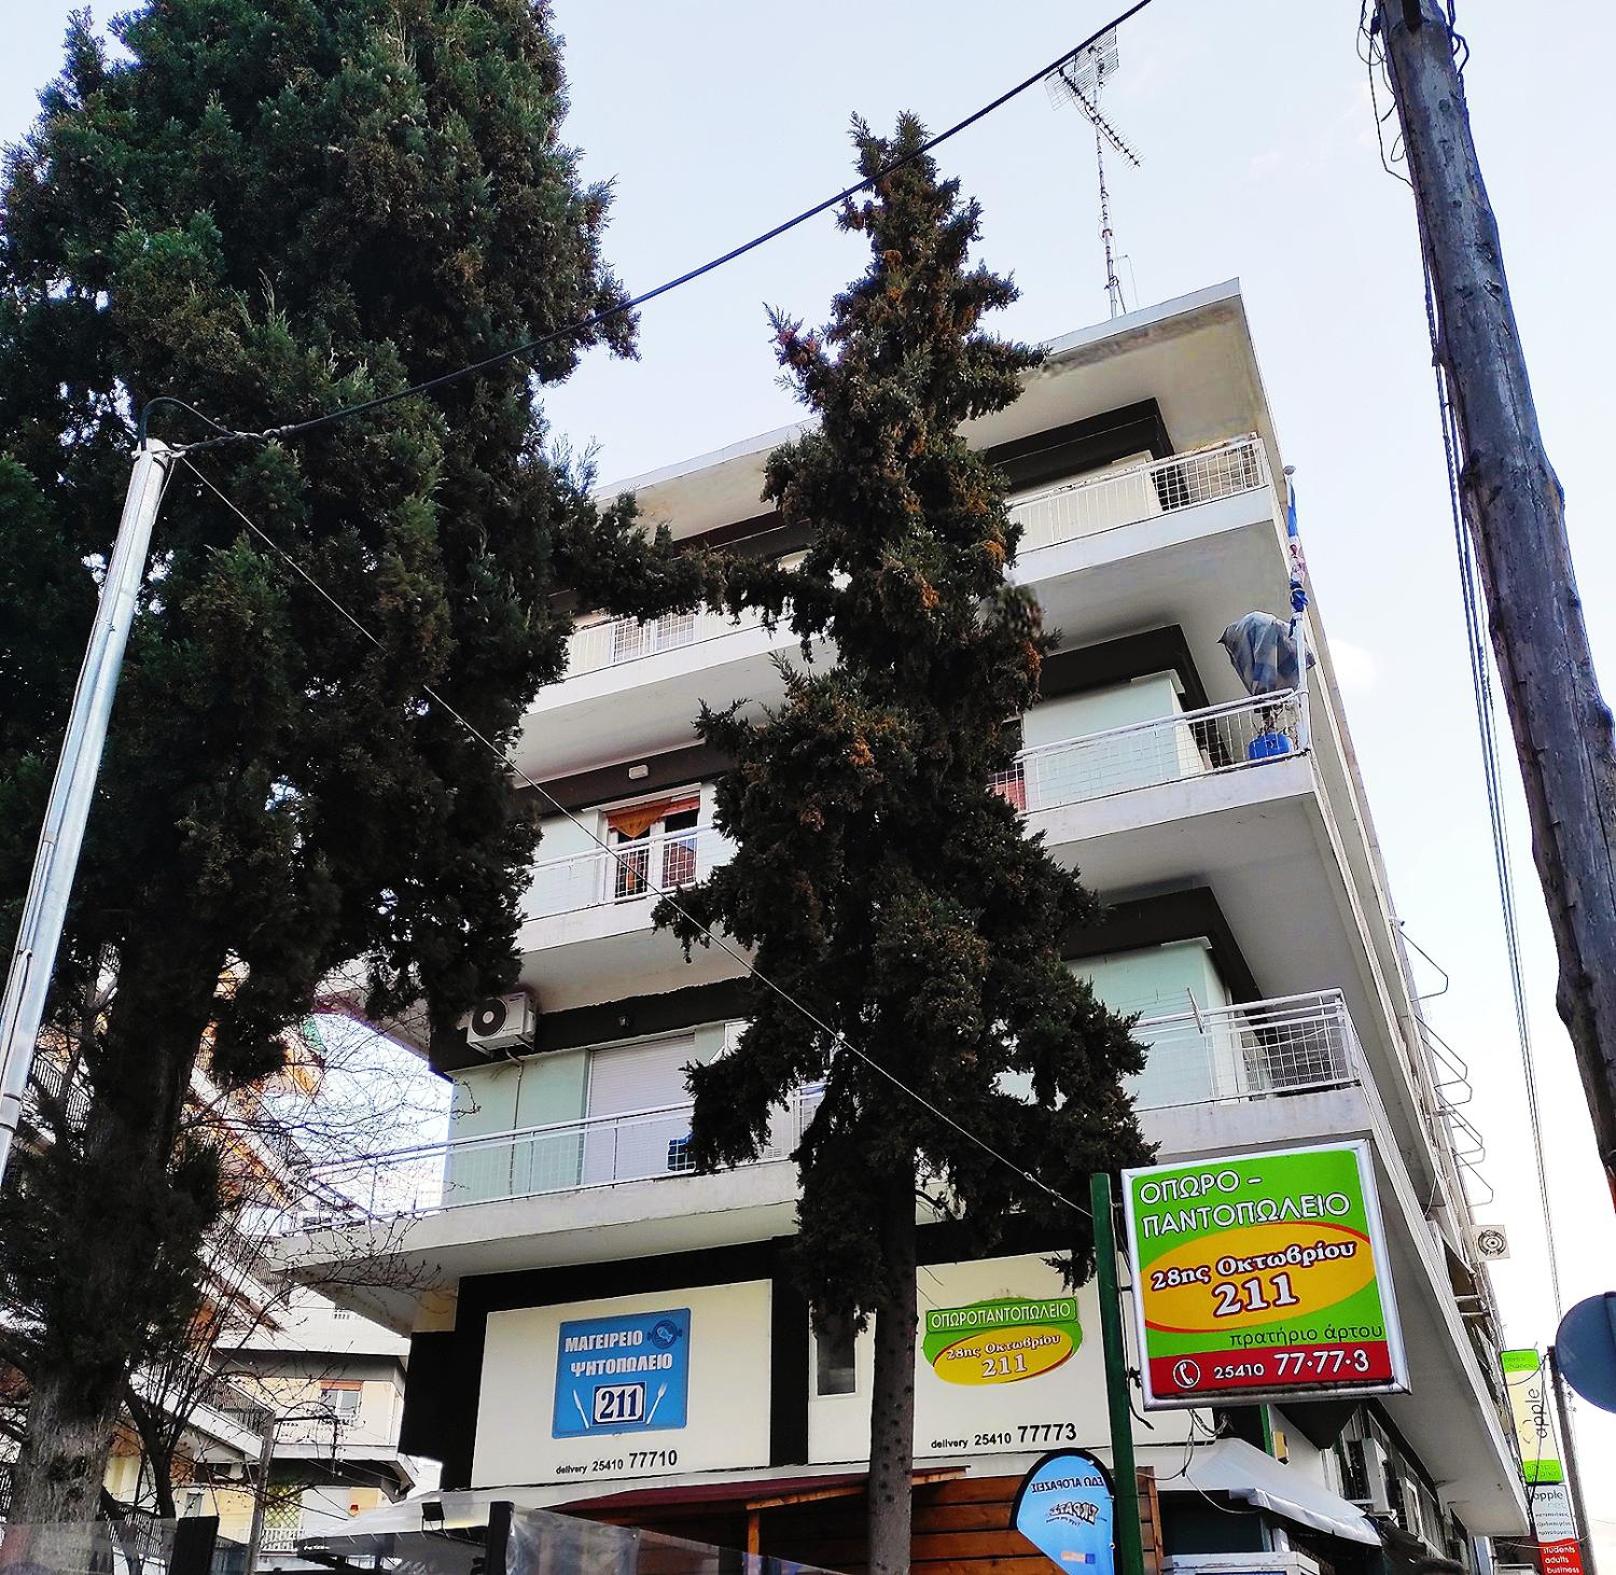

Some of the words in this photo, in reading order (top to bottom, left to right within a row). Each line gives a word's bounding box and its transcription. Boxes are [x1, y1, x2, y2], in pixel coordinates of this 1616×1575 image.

[1140, 1170, 1240, 1204] ΟΠΩΡΟ
[1142, 1193, 1351, 1239] ΠΑΝΤΟΠΩΛΕΙΟ
[1151, 1265, 1212, 1291] 28ης
[1216, 1240, 1358, 1277] Οκτωβρίου
[1212, 1273, 1299, 1317] 211
[931, 1302, 1071, 1329] ΟΠΩΡΟΠΑΝΤΟΠΩΛΕΙΟ
[564, 1330, 643, 1353] ΜΑΓΕΙΡΕΙΟ
[985, 1334, 1061, 1355] Οκτωβρίου
[1230, 1327, 1318, 1348] πρατήριο
[1324, 1324, 1383, 1342] άρτου
[570, 1353, 673, 1377] ΨΗΤΟΠΩΛΕΙΟ
[982, 1354, 1028, 1378] 211
[1214, 1363, 1265, 1379] 25410
[600, 1388, 638, 1419] 211
[931, 1438, 968, 1449] delivery
[974, 1432, 1012, 1446] 25410
[1018, 1423, 1077, 1443] 77773
[556, 1465, 588, 1475] delivery
[592, 1459, 624, 1472] 25410
[629, 1450, 678, 1468] 77710
[1545, 1556, 1569, 1564] adults
[1546, 1566, 1580, 1574] business
